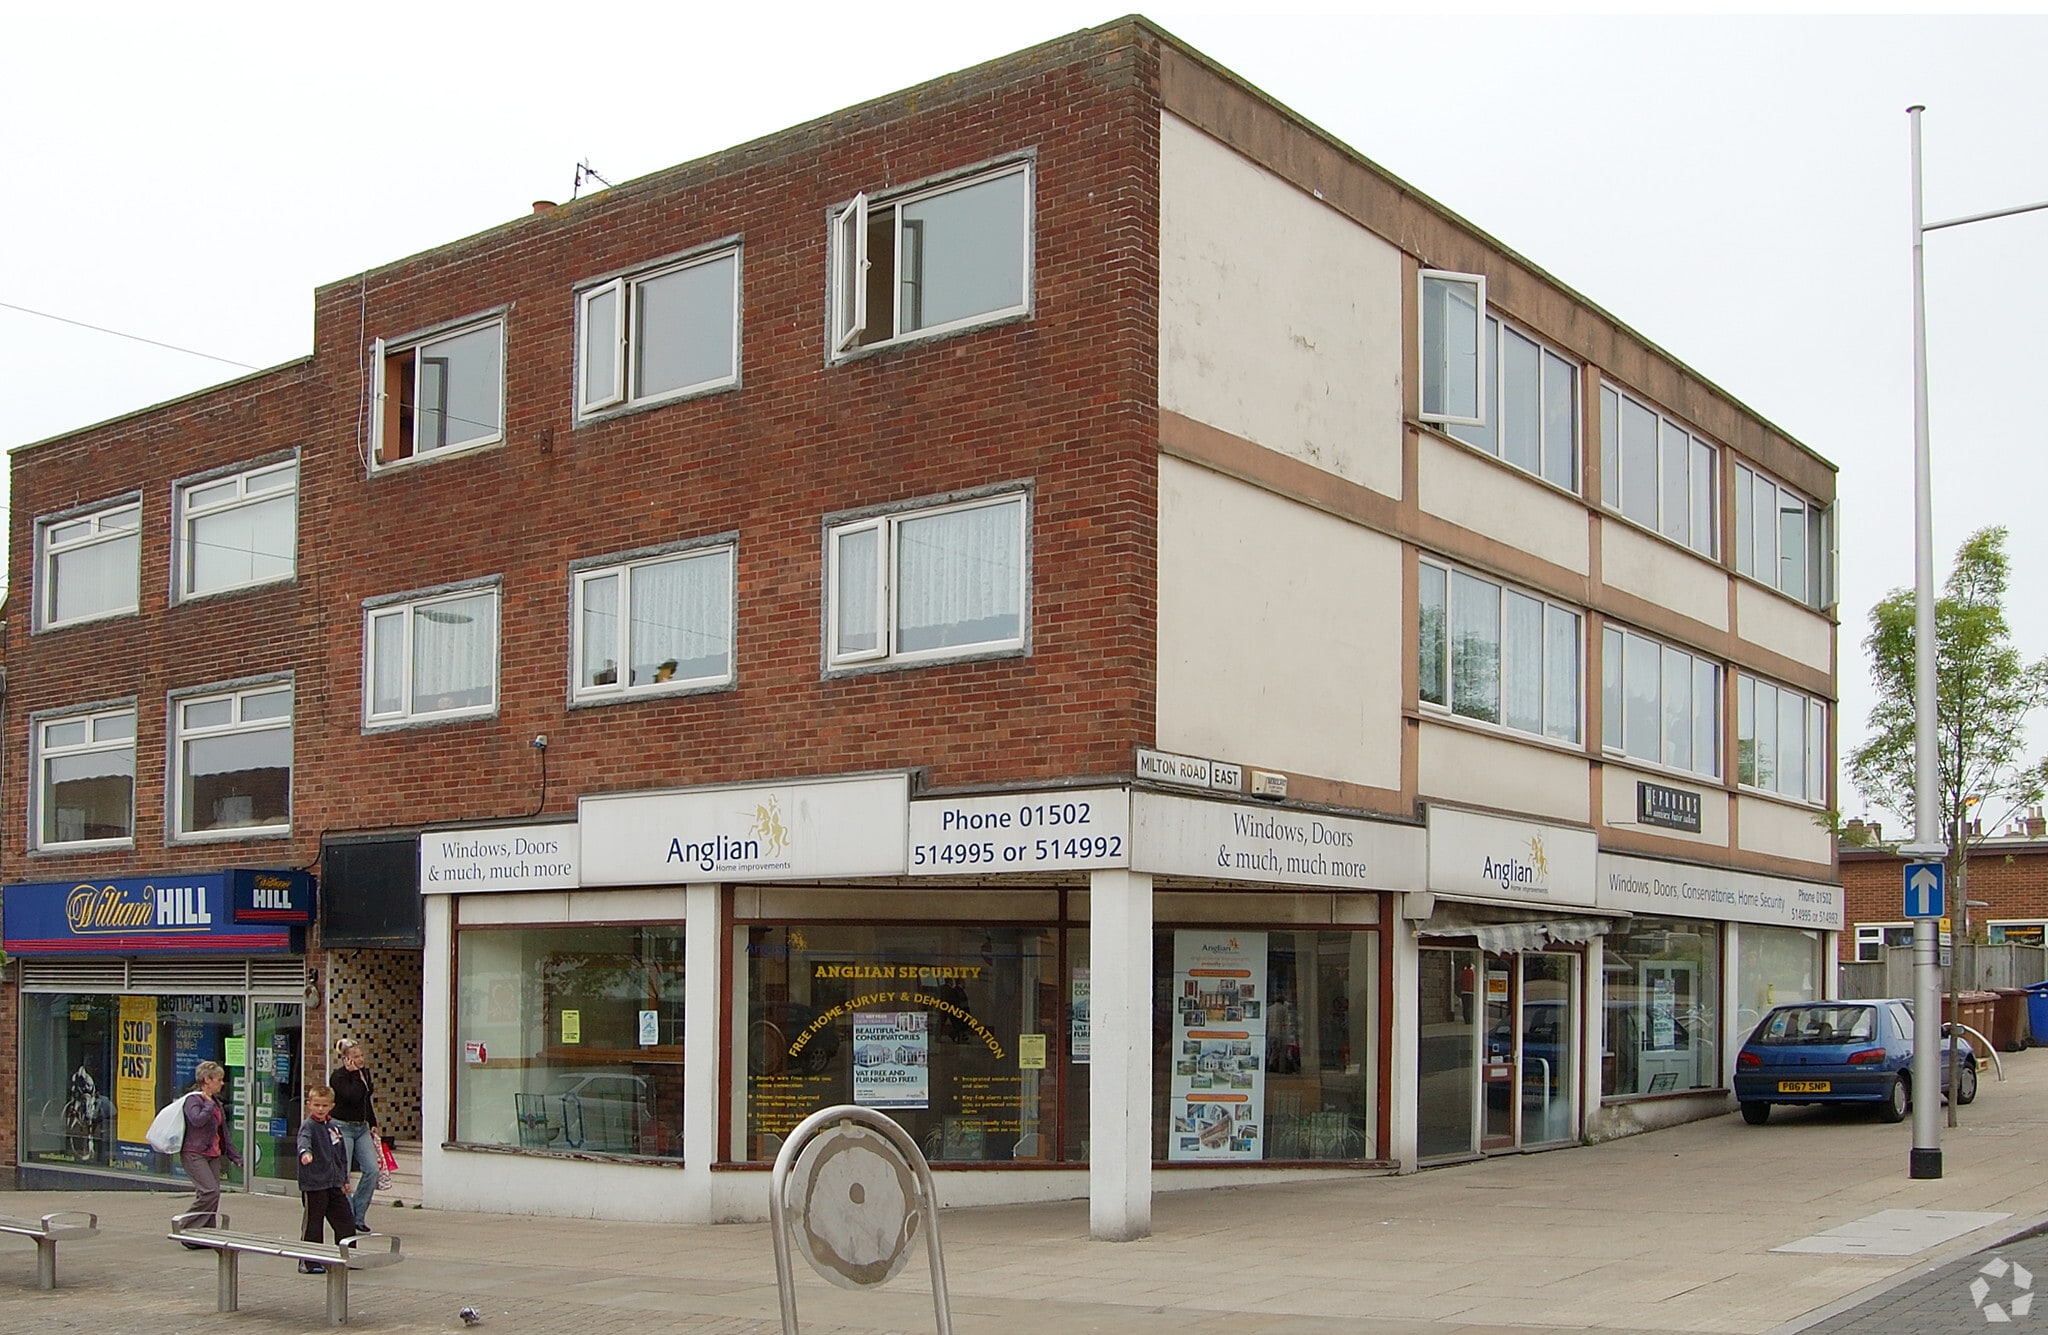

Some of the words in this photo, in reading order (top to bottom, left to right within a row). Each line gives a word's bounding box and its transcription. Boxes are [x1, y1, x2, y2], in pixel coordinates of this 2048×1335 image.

[1141, 756, 1176, 776] MILTON
[1180, 762, 1206, 781] ROAD
[1215, 768, 1238, 786] EAST
[943, 808, 1011, 831] Phone
[1020, 803, 1090, 827] 01502
[1233, 812, 1308, 846] Windows,
[1312, 822, 1353, 847] Doors
[442, 841, 511, 858] Windows,
[515, 838, 558, 855] Doors
[667, 835, 758, 872] Anglian
[914, 842, 995, 865] 514995
[1003, 846, 1027, 862] or
[1035, 836, 1122, 860] 514992
[428, 865, 439, 881] &
[444, 863, 485, 881] much,
[490, 860, 529, 879] much
[534, 862, 571, 876] more
[739, 862, 791, 872] improvements
[1217, 844, 1231, 867] &
[1236, 848, 1282, 876] much,
[1287, 853, 1327, 875] much
[1331, 861, 1366, 878] more
[255, 875, 292, 889] William
[1483, 856, 1532, 889] Anglian
[253, 889, 292, 909] HILL
[1609, 873, 1651, 897] Windows,
[1653, 879, 1679, 899] Doors,
[1739, 889, 1758, 906] Home
[1760, 892, 1785, 913] Security
[1798, 889, 1815, 903] Phone
[1816, 891, 1832, 905] 01502
[66, 884, 155, 931] William
[157, 887, 211, 925] HILL
[1812, 914, 1819, 922] or
[815, 966, 895, 979] ANGLIAN
[899, 967, 982, 979] SECURITY
[123, 1021, 152, 1042] STOP
[789, 1030, 812, 1057] FREE
[809, 1005, 843, 1033] HOME
[845, 992, 896, 1012] SURVEY
[900, 992, 910, 1002] &
[914, 993, 1006, 1060] DEMONSTRATION
[122, 1043, 152, 1056] WALKING
[122, 1056, 151, 1078] PAST
[1809, 1082, 1827, 1091] SNP
